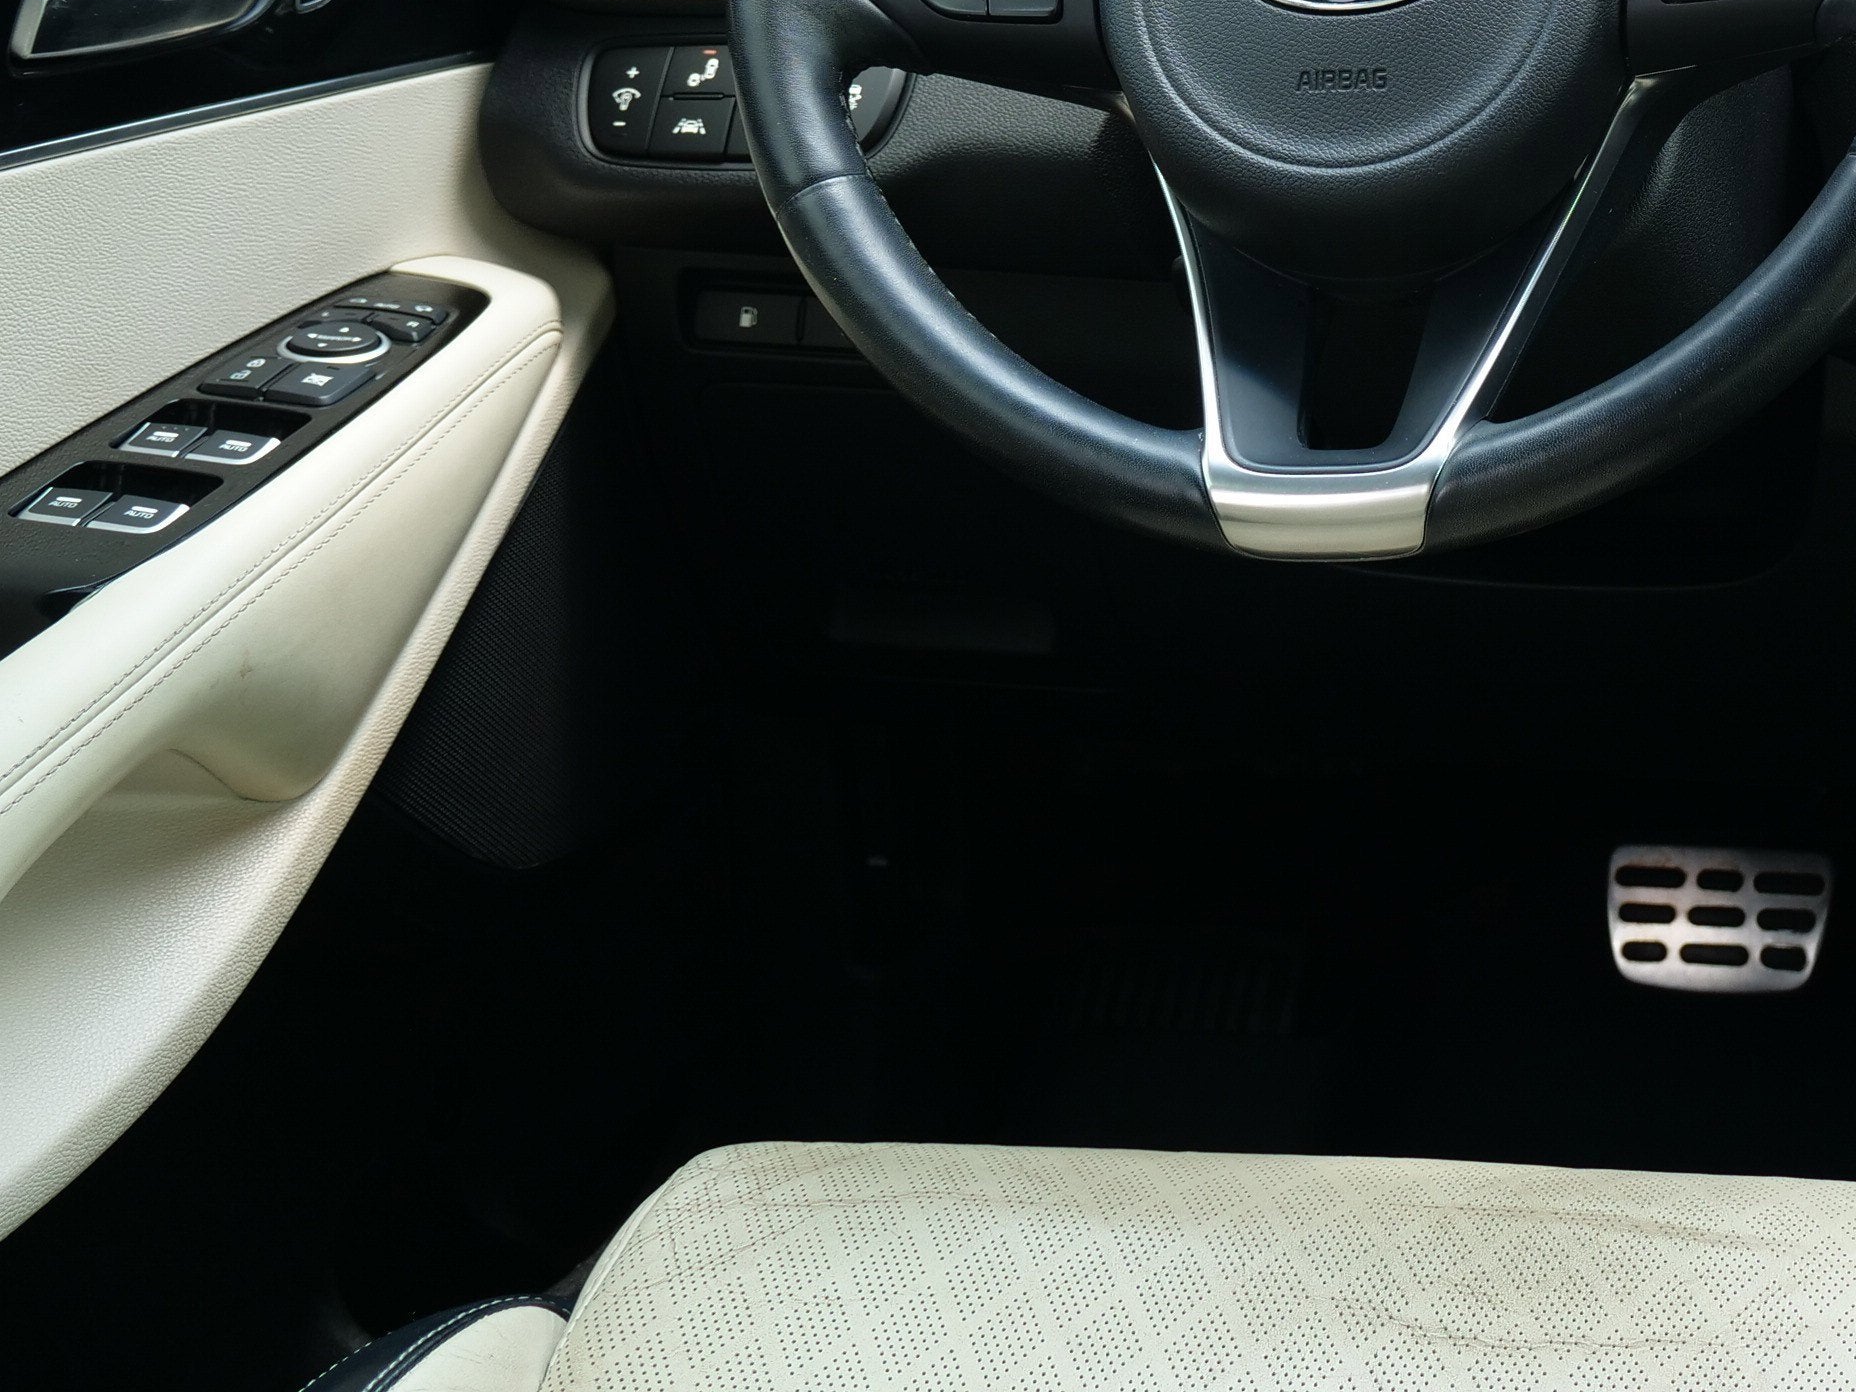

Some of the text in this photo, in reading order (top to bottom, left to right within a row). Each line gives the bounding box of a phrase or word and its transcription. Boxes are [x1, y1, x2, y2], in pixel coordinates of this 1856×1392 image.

[1297, 68, 1389, 92] AIRBAG
[219, 443, 248, 453] AUTO
[48, 499, 78, 509] AUTO
[124, 510, 154, 519] AUTO
